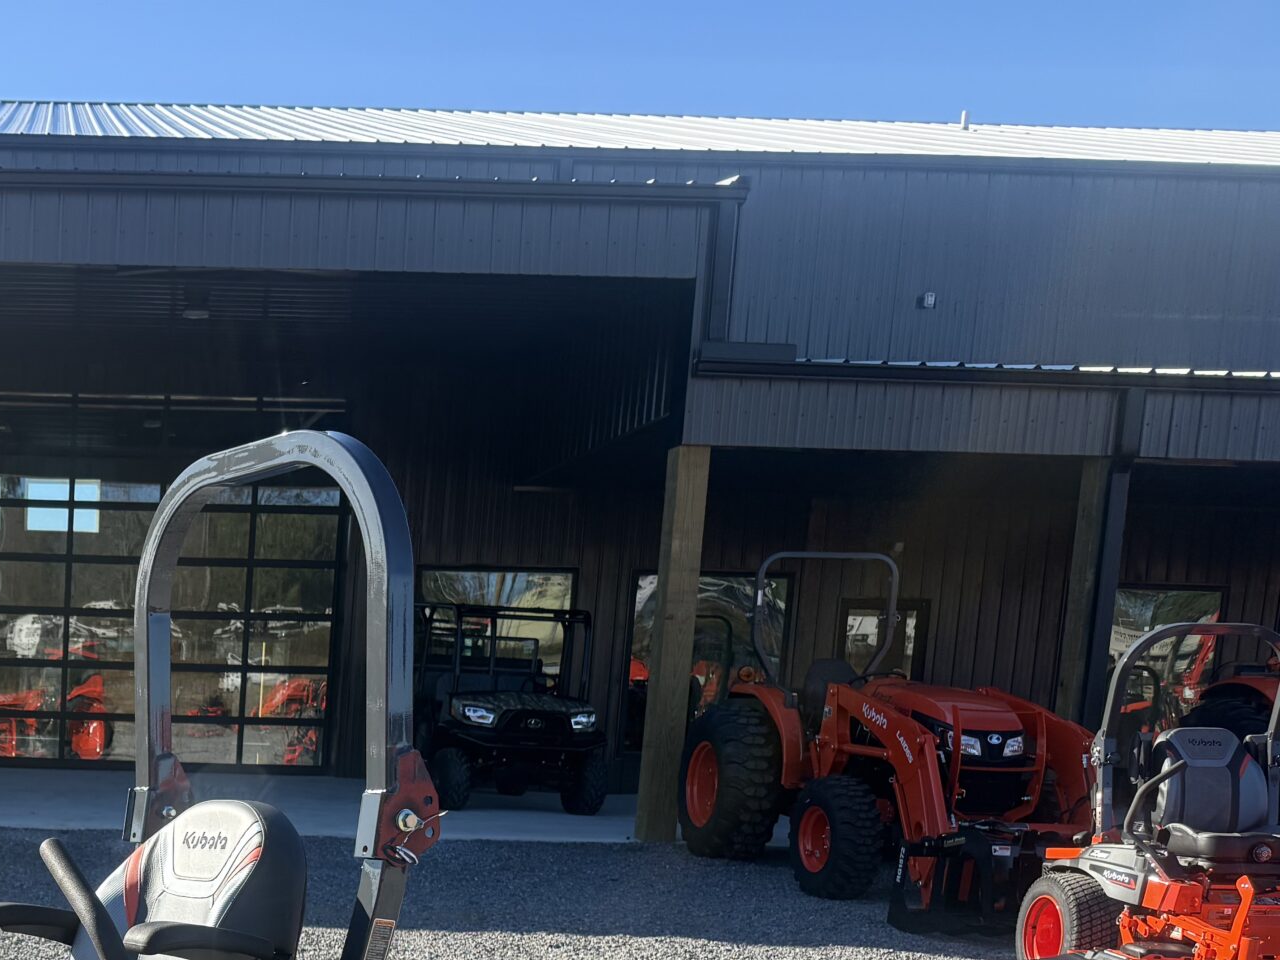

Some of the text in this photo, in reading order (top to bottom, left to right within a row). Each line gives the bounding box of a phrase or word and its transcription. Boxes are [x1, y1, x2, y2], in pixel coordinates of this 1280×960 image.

[862, 702, 888, 729] Kubota
[1188, 738, 1222, 747] Kubota
[182, 831, 228, 850] Kubota
[1102, 869, 1129, 883] Kubota
